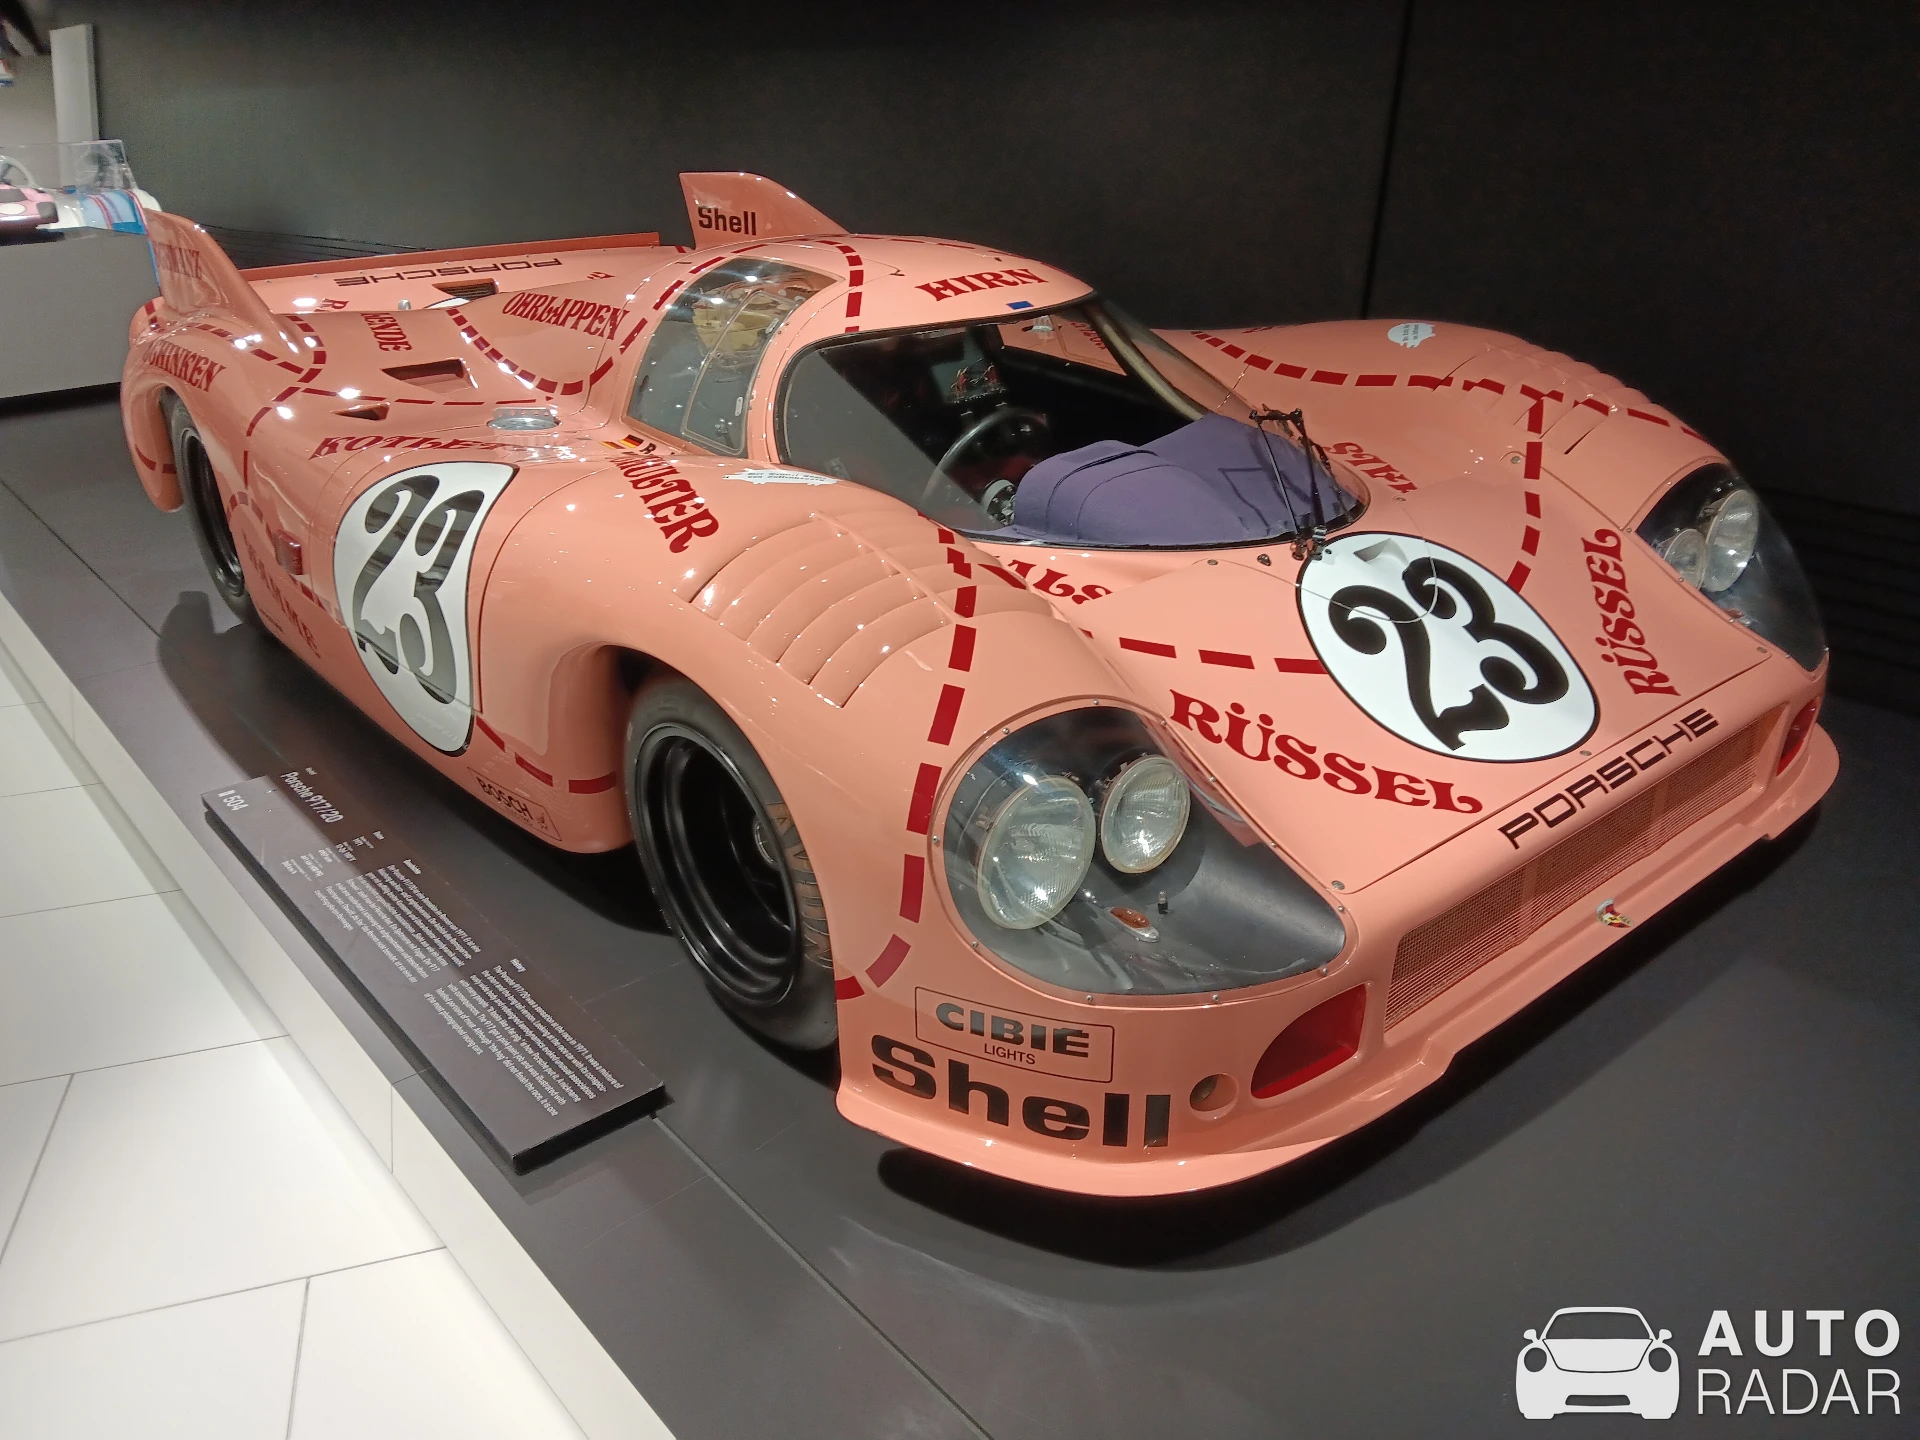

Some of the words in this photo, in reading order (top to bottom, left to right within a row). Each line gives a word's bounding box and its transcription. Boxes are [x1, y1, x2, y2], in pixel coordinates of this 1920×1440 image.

[698, 206, 757, 236] Shell
[333, 257, 562, 287] PORSCHE
[917, 268, 1048, 302] HIRN
[502, 291, 630, 340] OHRLAPPEN
[353, 474, 485, 704] 23
[1581, 528, 1682, 696] RÜSSEL
[1328, 557, 1569, 752] 23
[1170, 688, 1483, 815] RÜSSEL
[280, 771, 314, 798] Porsche
[305, 795, 344, 823] 917/20
[476, 777, 533, 819] BOSCH
[1497, 707, 1719, 850] PORSCHE
[984, 1042, 1036, 1065] LIGHTS
[871, 1033, 1172, 1148] Shell
